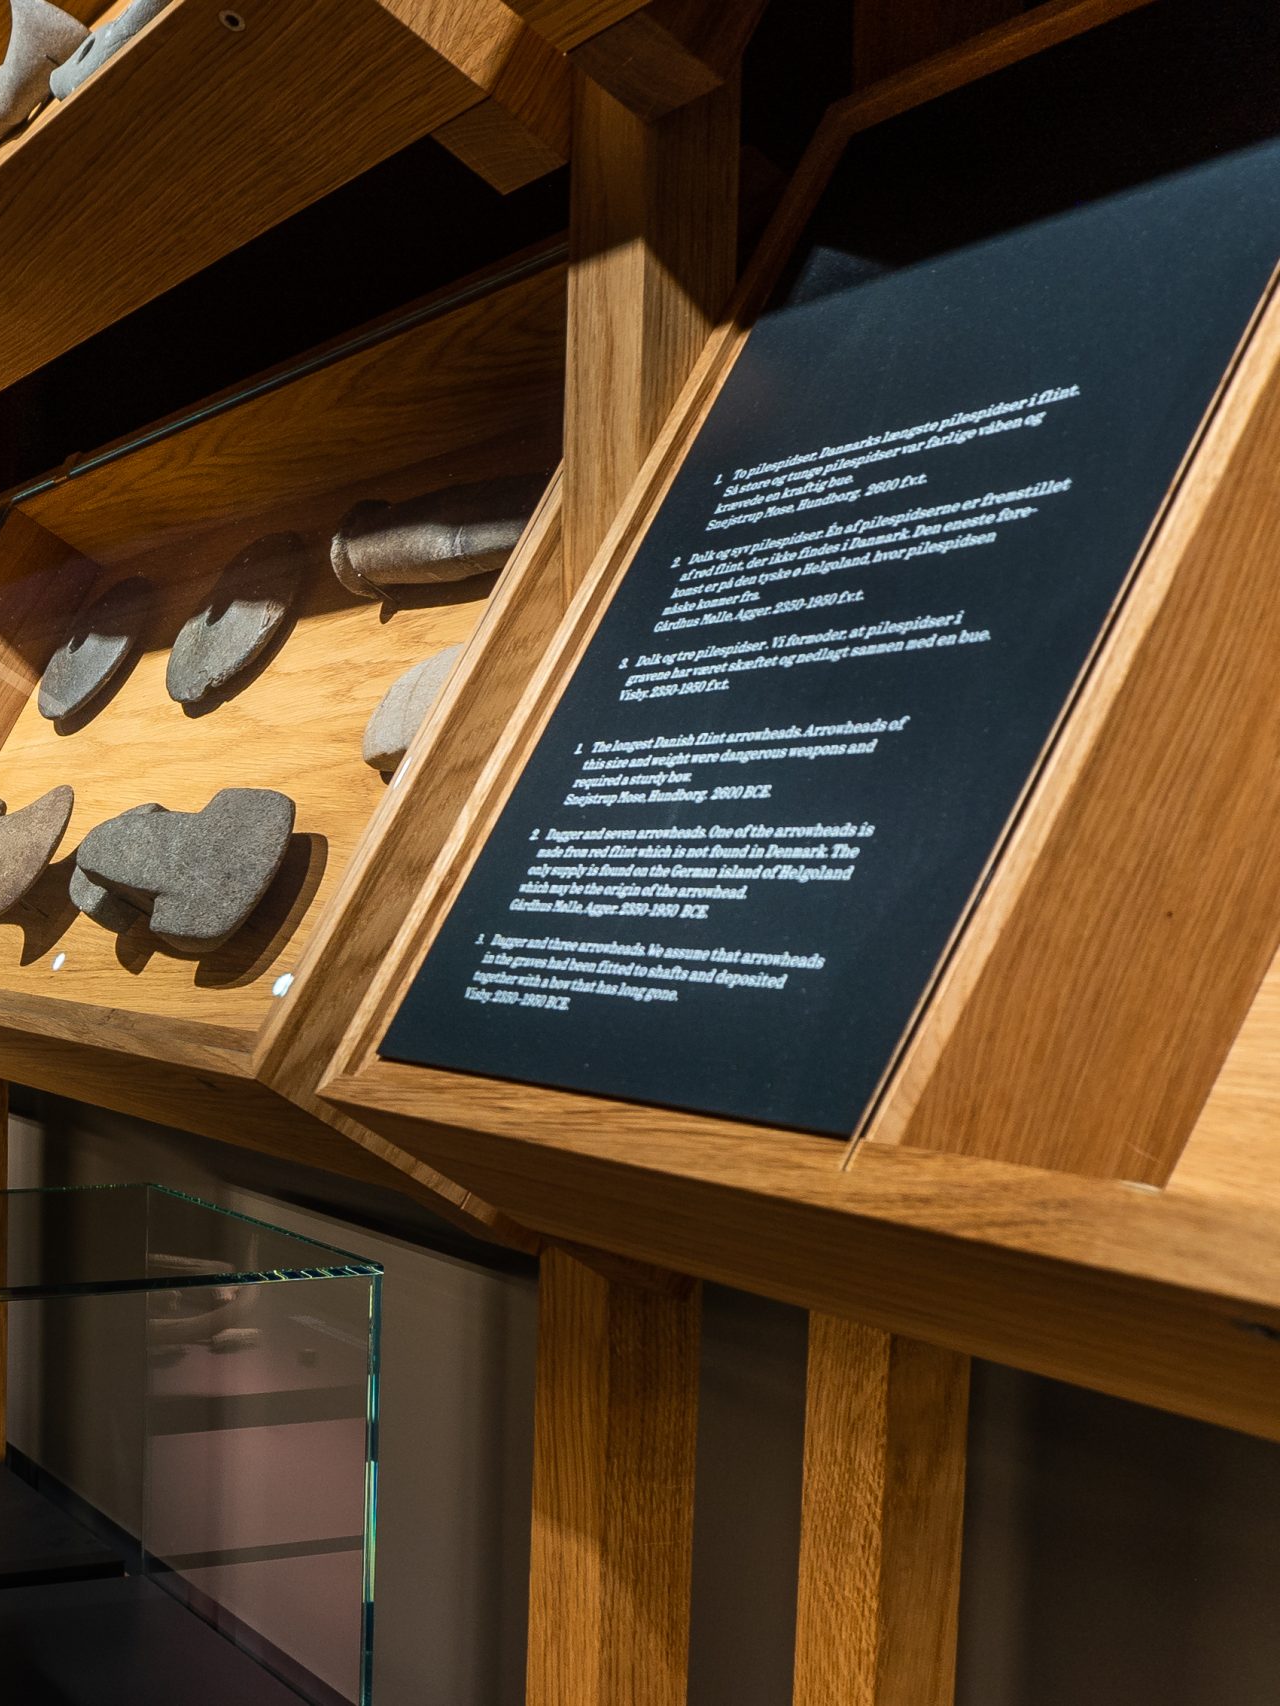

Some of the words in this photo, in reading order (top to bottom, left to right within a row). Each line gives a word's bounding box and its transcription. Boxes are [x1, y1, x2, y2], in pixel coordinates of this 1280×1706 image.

[818, 435, 882, 459] Danmarks
[881, 421, 939, 443] længste
[937, 398, 1028, 432] pilespidser
[723, 484, 739, 497] Så
[739, 479, 771, 493] store
[771, 474, 788, 486] og
[787, 466, 823, 482] tunge
[821, 447, 902, 476] pilespidser
[902, 441, 926, 454] var
[924, 429, 977, 449] farlige
[979, 417, 1023, 436] våben
[1024, 411, 1046, 426] og
[714, 494, 765, 514] krævede
[765, 492, 780, 502] en
[781, 479, 829, 499] kraftig
[864, 478, 900, 496] 2600
[688, 550, 716, 565] Dolk
[716, 549, 731, 560] og
[730, 545, 752, 557] syv
[825, 522, 843, 537] Én
[844, 519, 863, 534] af
[858, 502, 961, 533] pilespidserne
[961, 498, 981, 510] er
[980, 478, 1072, 507] fremstillet
[680, 569, 696, 581] af
[746, 557, 769, 569] der
[768, 551, 797, 565] ikke
[797, 543, 841, 559] findes
[912, 524, 942, 538] Den
[943, 513, 996, 532] eneste
[996, 506, 1038, 522] fore-
[671, 584, 704, 598] komst
[704, 583, 719, 592] er
[716, 577, 734, 593] på
[734, 575, 757, 587] den
[758, 568, 792, 585] tyske
[872, 548, 907, 563] hvor
[904, 532, 996, 560] pilespidsen
[662, 601, 696, 615] måske
[696, 595, 740, 610] kommer
[635, 653, 662, 667] Dolk
[662, 653, 678, 665] og
[677, 651, 696, 661] tre
[848, 626, 866, 638] at
[864, 615, 955, 639] pilespidser
[654, 617, 700, 632] Gårdhus
[625, 670, 671, 687] gravene
[670, 667, 693, 679] har
[692, 662, 728, 675] været
[727, 656, 779, 672] skæftet
[779, 654, 797, 667] og
[795, 646, 850, 663] nedlagt
[850, 641, 904, 657] sammen
[905, 633, 937, 650] med
[936, 634, 957, 646] en
[592, 741, 612, 753] The
[610, 738, 654, 753] longest
[653, 733, 695, 748] Danish
[694, 732, 727, 745] flint
[802, 718, 888, 737] Arrowheads
[888, 715, 910, 731] of
[582, 758, 606, 770] this
[605, 756, 629, 769] size
[628, 754, 652, 768] and
[651, 752, 691, 768] weight
[691, 752, 720, 763] were
[720, 748, 788, 763] dangerous
[788, 744, 847, 759] weapons
[847, 738, 878, 754] and
[572, 773, 623, 790] required
[629, 771, 669, 786] sturdy
[710, 785, 744, 800] 2600
[582, 827, 606, 840] and
[603, 830, 637, 839] seven
[708, 825, 734, 838] One
[734, 824, 753, 838] of
[749, 824, 774, 838] the
[773, 822, 858, 838] arrowheads
[857, 821, 875, 837] is
